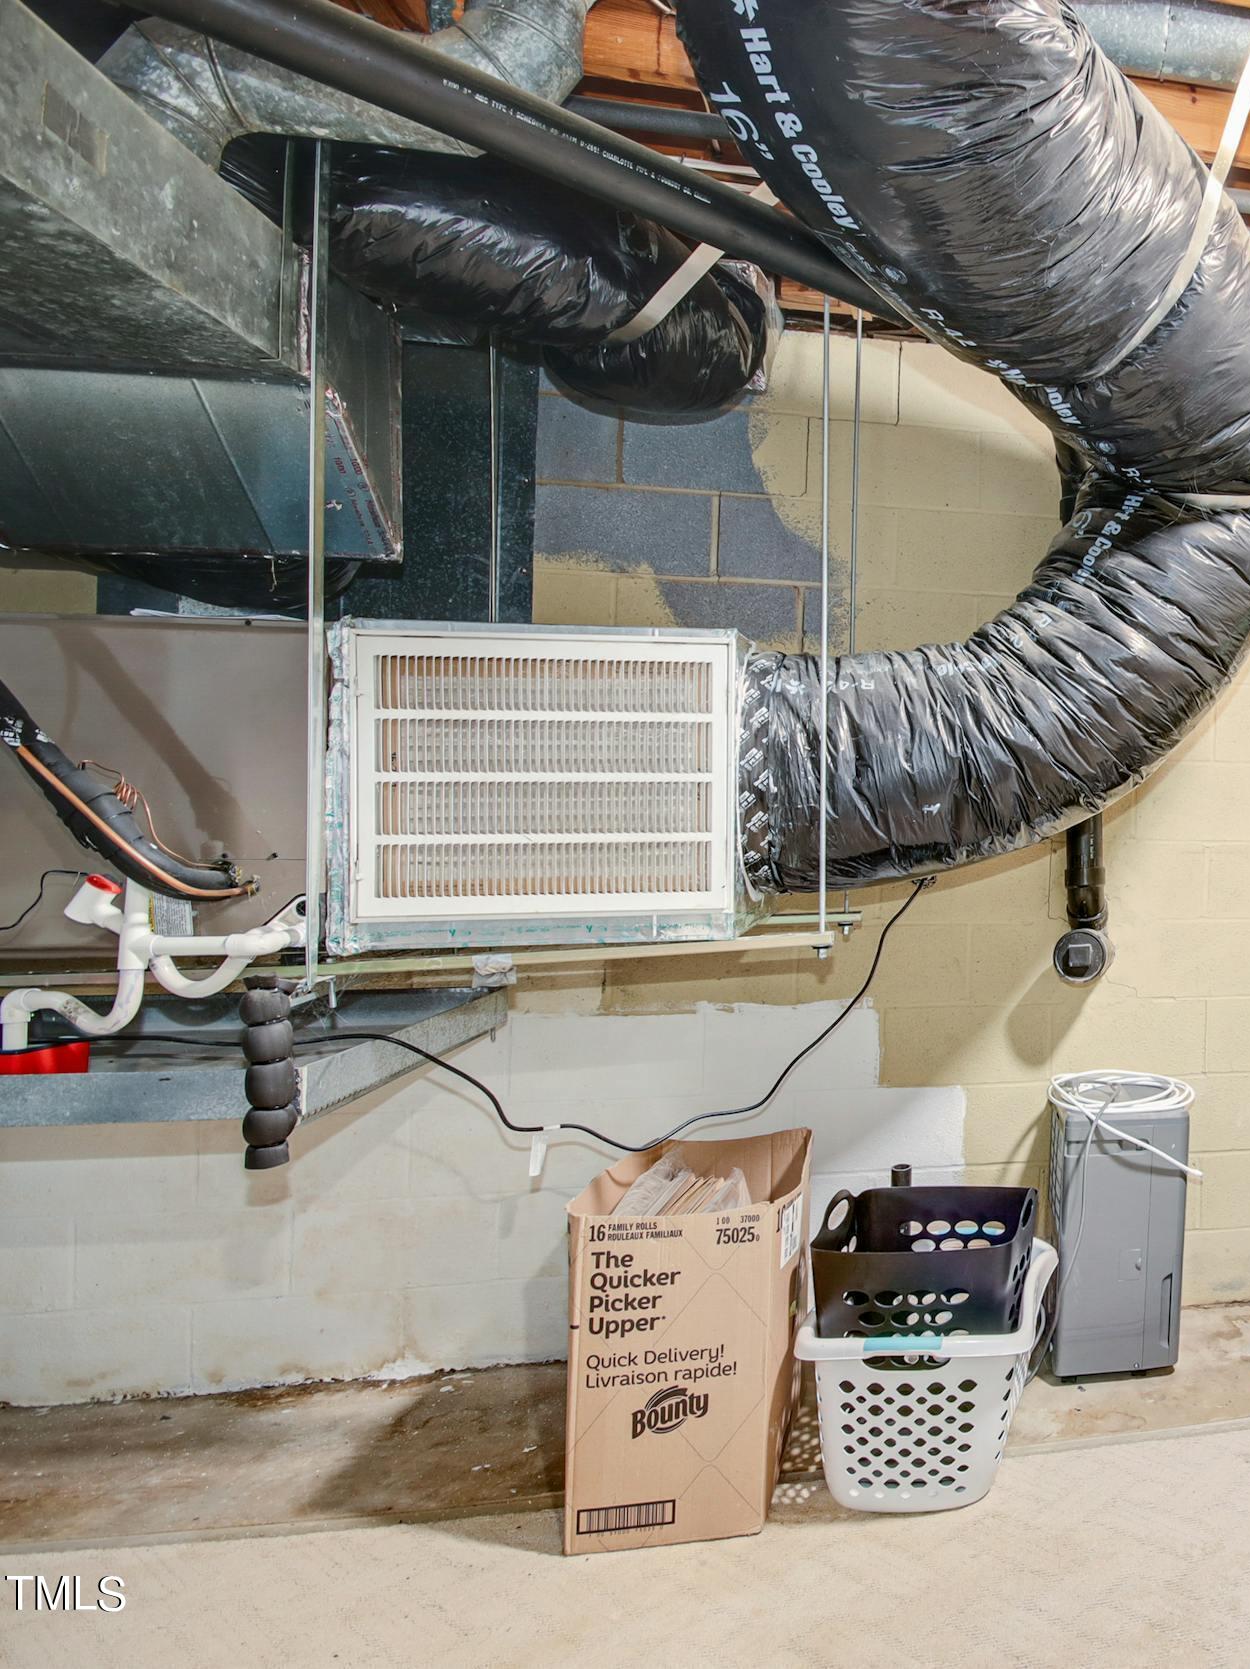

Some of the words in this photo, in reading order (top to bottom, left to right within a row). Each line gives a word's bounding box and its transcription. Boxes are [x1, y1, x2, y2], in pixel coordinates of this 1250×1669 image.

[740, 28, 772, 104] Hart
[774, 111, 803, 138] &
[791, 144, 860, 230] Cooley
[1045, 386, 1082, 425] oley
[1101, 520, 1122, 535] &
[740, 1214, 760, 1224] 37000
[589, 1224, 606, 1242] 16
[608, 1223, 634, 1232] FAMILY
[636, 1221, 658, 1231] ROLLS
[607, 1231, 645, 1241] ROULEAUX
[646, 1229, 684, 1240] FAMILIAUX
[715, 1226, 755, 1245] 75025
[591, 1251, 634, 1269] The
[590, 1269, 681, 1293] Quicker
[589, 1293, 662, 1313] Picker
[586, 1352, 639, 1371] Quick
[644, 1344, 725, 1365] Delivery!
[585, 1370, 669, 1389] Livraison
[674, 1361, 738, 1383] rapide!
[631, 1392, 709, 1440] Bounty
